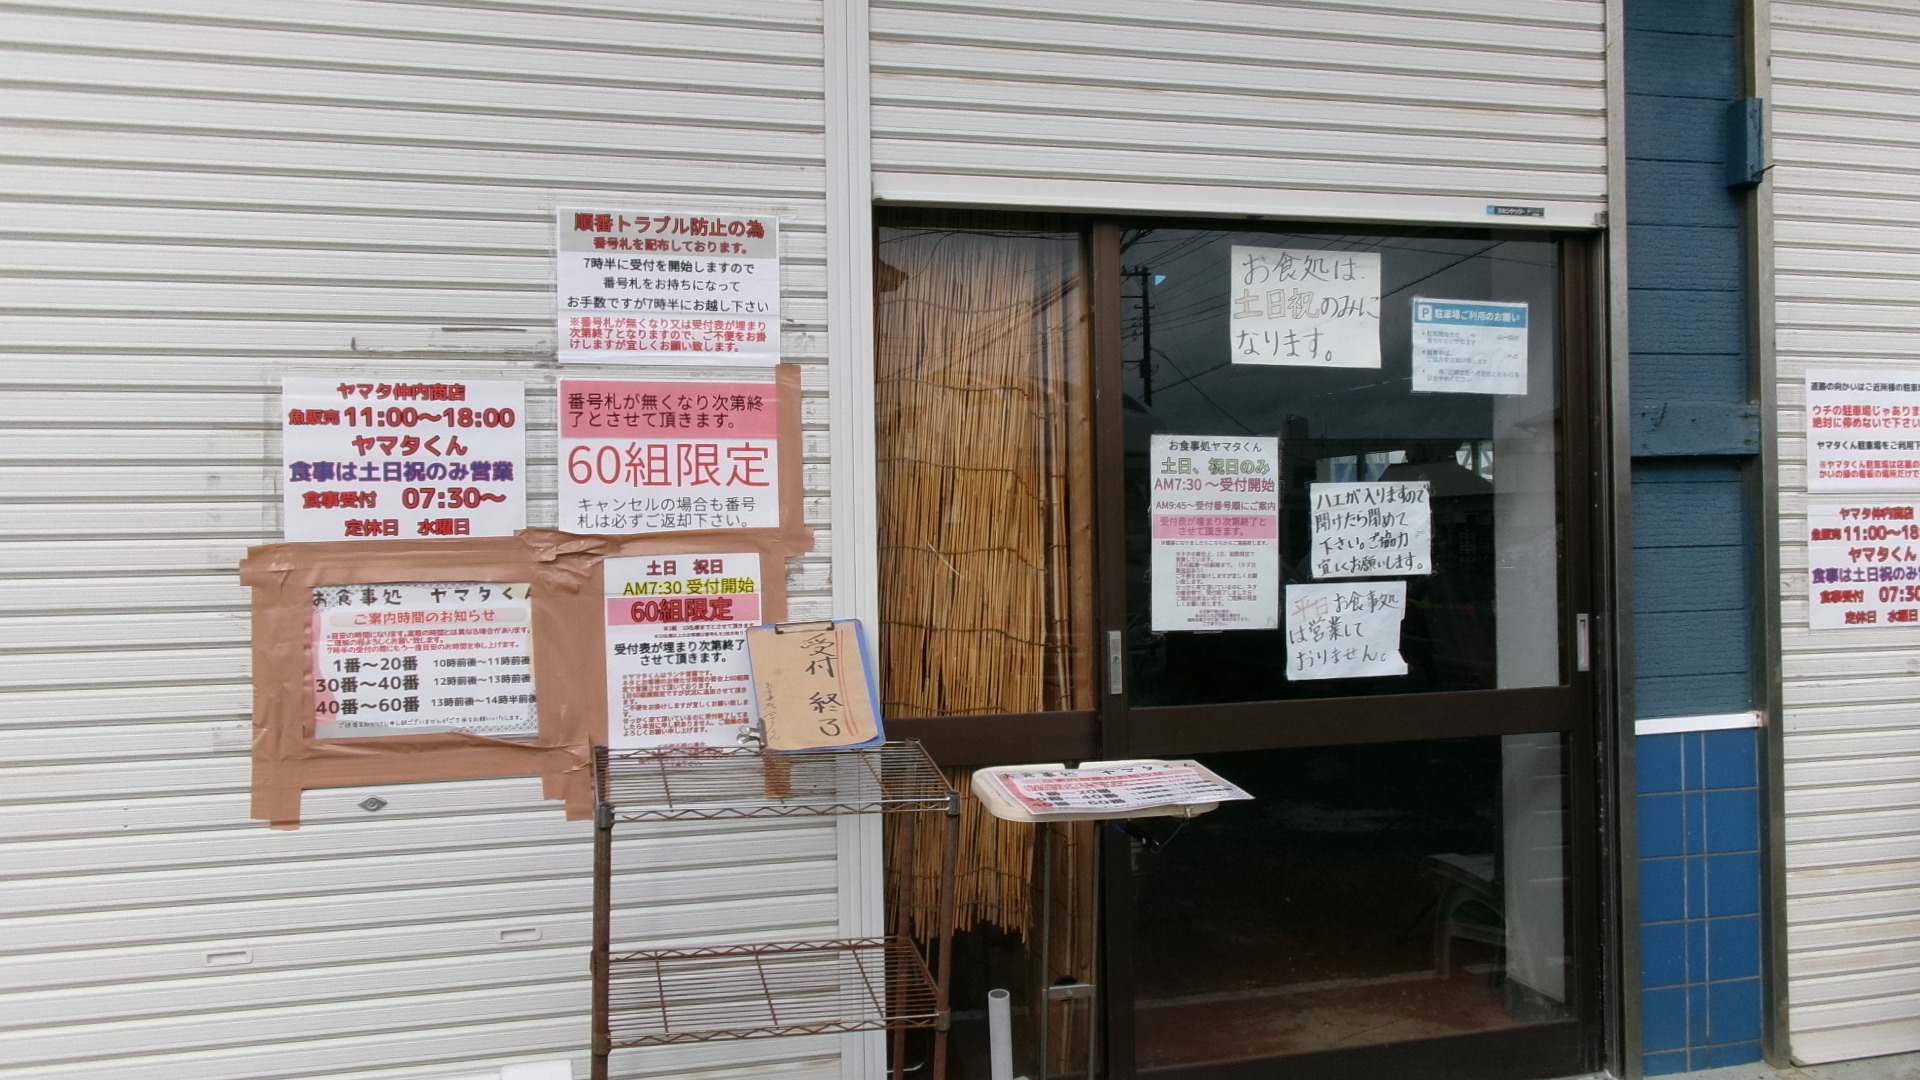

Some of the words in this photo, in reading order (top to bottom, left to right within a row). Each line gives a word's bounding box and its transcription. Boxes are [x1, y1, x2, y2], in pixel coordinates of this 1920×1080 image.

[574, 212, 764, 239] 順番トラブル防止の為
[593, 236, 748, 254] 番号札を配布しております。
[583, 257, 755, 274] 7時半に受付を開始しますので
[603, 277, 741, 292] 番号札をお持ちになって
[567, 296, 769, 313] お手数ですが7時半にお越し下さい
[1233, 288, 1380, 319] 土日祝のみに
[569, 317, 766, 331] ※番号札が無くなり又は受付表が埋まり
[569, 328, 767, 342] 次第終了となりますので、ご不便をお掛
[1235, 327, 1332, 362] なります。
[569, 339, 740, 353] けしますが宜しくお願い致します。
[337, 383, 466, 401] ヤマタ仲内商店
[568, 392, 764, 412] 番号札が無くなり次第終
[288, 408, 340, 426] 魚販売
[344, 407, 516, 428] 11:00〜18:00
[568, 411, 736, 429] 了とさせて頂きます。
[352, 435, 468, 456] ヤマタくん
[1169, 440, 1262, 452] お食事処ヤマタくん
[289, 460, 514, 483] 食事は土日祝のみ営業
[568, 441, 770, 488] 60組限定
[1154, 478, 1202, 491] AM7:30
[302, 490, 377, 509] 食事受付
[402, 487, 507, 509] 07:30〜
[578, 496, 756, 513] キャンセルの場合も番号
[1316, 483, 1430, 511] ハエが入りますので
[345, 518, 399, 537] 定休日
[417, 518, 470, 536] 水曜日
[577, 512, 750, 529] 札は必ずご返却下さい。
[1319, 530, 1409, 555] 下さい。ご協力
[1848, 546, 1917, 563] ヤマタくん
[646, 560, 677, 576] 土日
[693, 559, 723, 575] 祝日
[623, 581, 682, 596] AM7:30
[687, 577, 755, 594] 受付開始
[312, 588, 403, 607] お食事処
[353, 609, 496, 626] ご案内時間のお知らせ
[630, 597, 734, 623] 60組限定
[1289, 616, 1365, 644] は営業して
[614, 639, 746, 655] 受付表が埋まり次第終了
[333, 655, 419, 674] 1番〜20番
[433, 656, 531, 668] 10時前後〜11時前後
[640, 651, 727, 667] させて頂きます。
[316, 674, 420, 695] 30番〜40番
[433, 674, 531, 687] 12時前後〜13時前後
[316, 696, 420, 716] 40番〜60番
